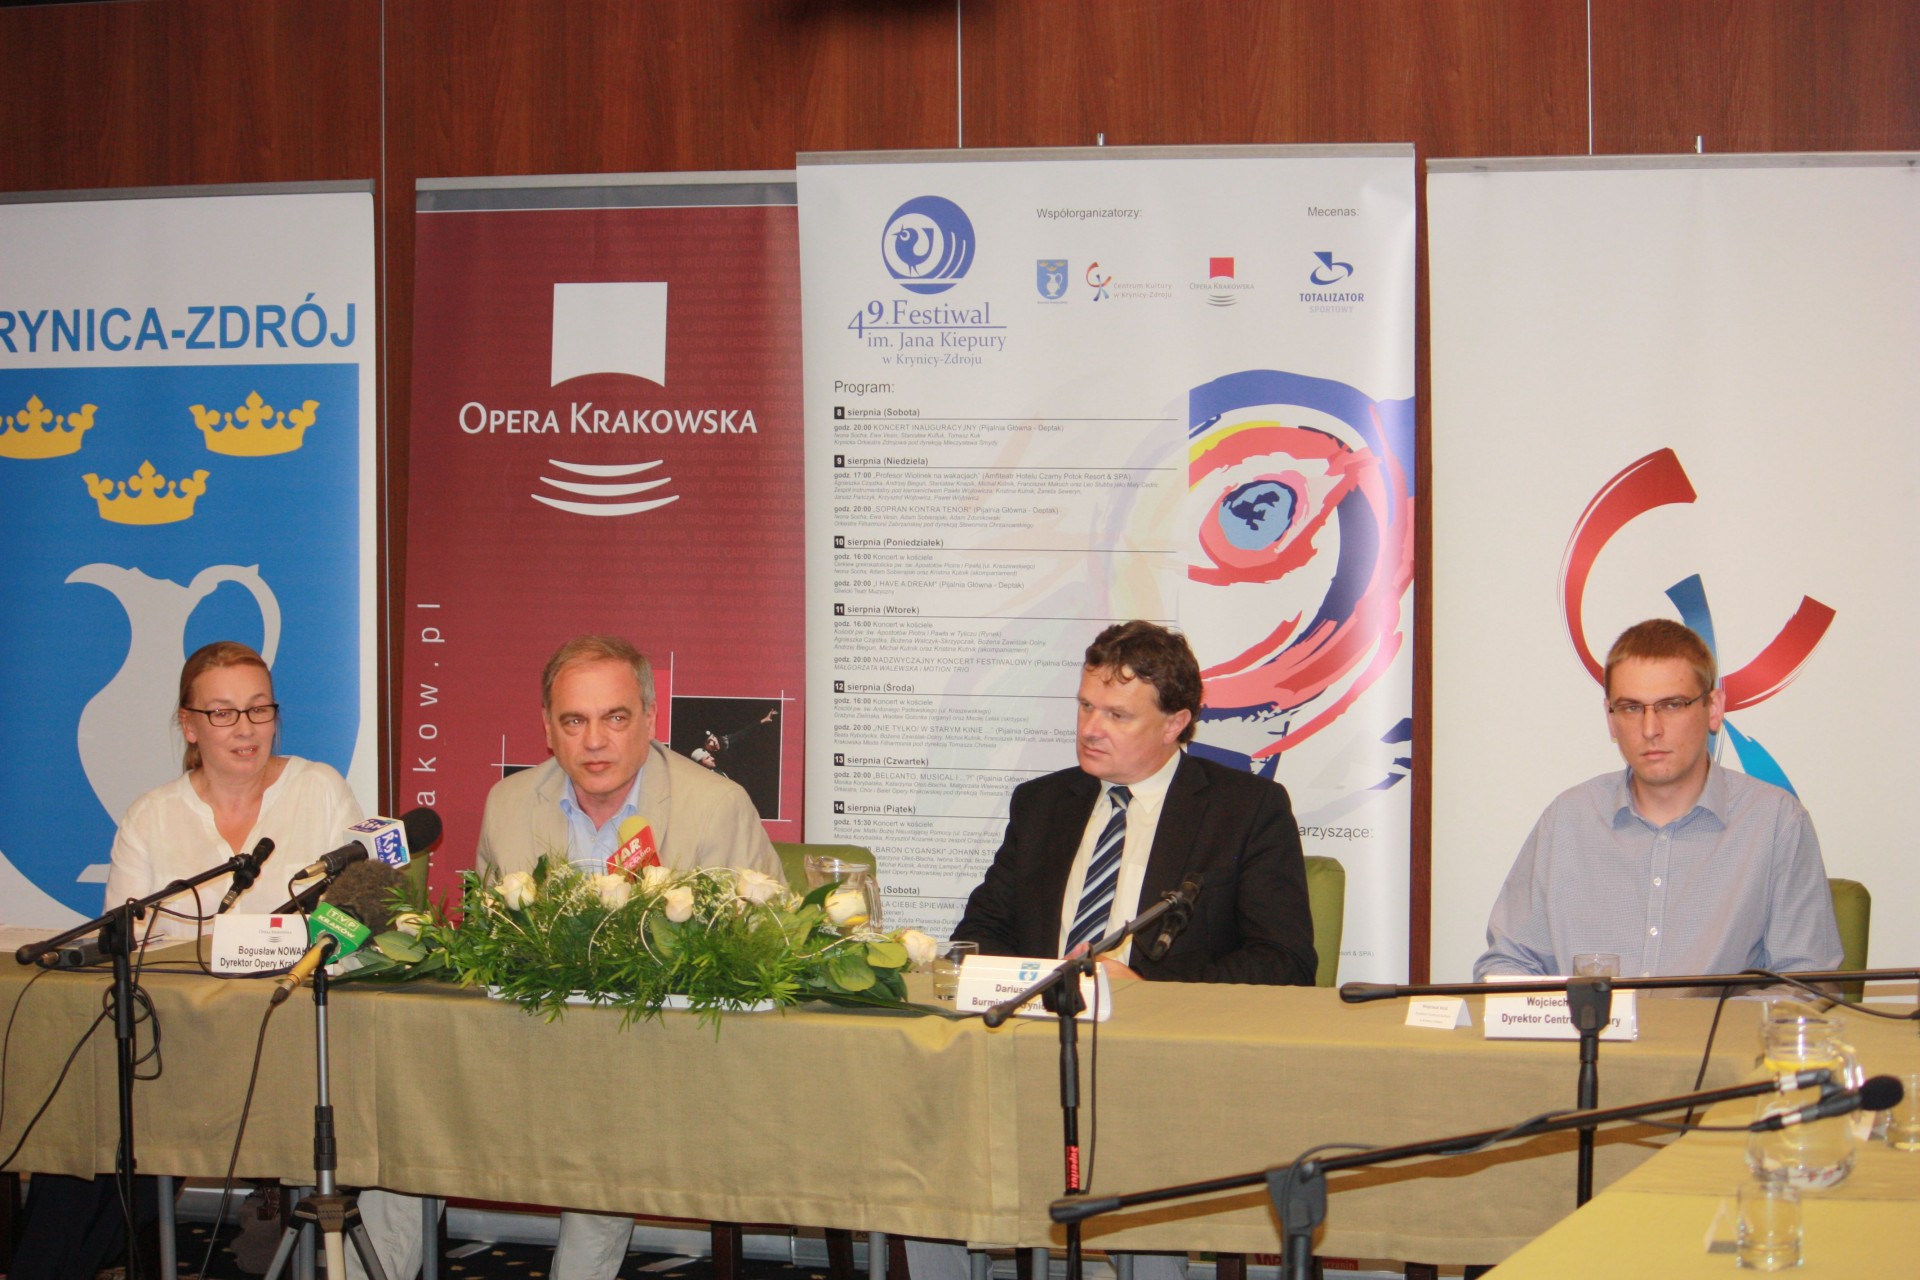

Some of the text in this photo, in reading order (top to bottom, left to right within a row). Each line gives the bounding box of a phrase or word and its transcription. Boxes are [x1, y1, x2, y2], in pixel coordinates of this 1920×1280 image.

[1036, 207, 1143, 220] Współorganizatorzy:
[1307, 206, 1360, 217] Mecenas:
[1145, 282, 1172, 290] Kultury
[1121, 291, 1172, 299] Krynicy-Zdroju
[1300, 293, 1365, 303] TOTALIZATOR
[892, 300, 991, 325] Festiwal
[1309, 305, 1354, 313] SPORTOWY
[868, 331, 1007, 351] im. Jana Kiepury
[883, 353, 982, 367] w Krynicy-Zdroju
[834, 380, 895, 396] Program:
[847, 408, 882, 418] sierpnia
[883, 408, 920, 418] (Sobota)
[834, 424, 852, 432] godz.
[847, 457, 882, 467] sierpnia
[883, 457, 928, 467] (Niedziela)
[834, 472, 852, 480] godz.
[834, 506, 852, 514] godz.
[847, 538, 882, 548] sierpnia
[883, 539, 944, 549] (Poniedziałek)
[834, 553, 852, 561] godz.
[834, 580, 852, 588] godz.
[847, 605, 882, 615] sierpnia
[883, 606, 920, 616] (Wtorek)
[834, 620, 852, 628] godz.
[834, 656, 852, 664] godz.
[847, 683, 882, 694] sierpnia
[883, 683, 915, 694] (Środa)
[834, 697, 852, 705] godz.
[834, 724, 852, 732] godz.
[847, 756, 882, 767] sierpnia
[883, 757, 929, 768] (Czwartek)
[834, 771, 852, 780] godz.
[847, 804, 882, 815] sierpnia
[883, 805, 916, 816] (Piątek)
[834, 819, 852, 827] godz.
[1298, 826, 1374, 841] arzyszące:
[884, 886, 920, 897] (Sobota)
[328, 908, 359, 930] TVP
[238, 946, 275, 956] Bogusław
[220, 958, 252, 969] Dyrektor
[255, 959, 277, 970] Opery
[1526, 997, 1568, 1008] Wojciech
[1502, 1013, 1542, 1025] Dyrektor
